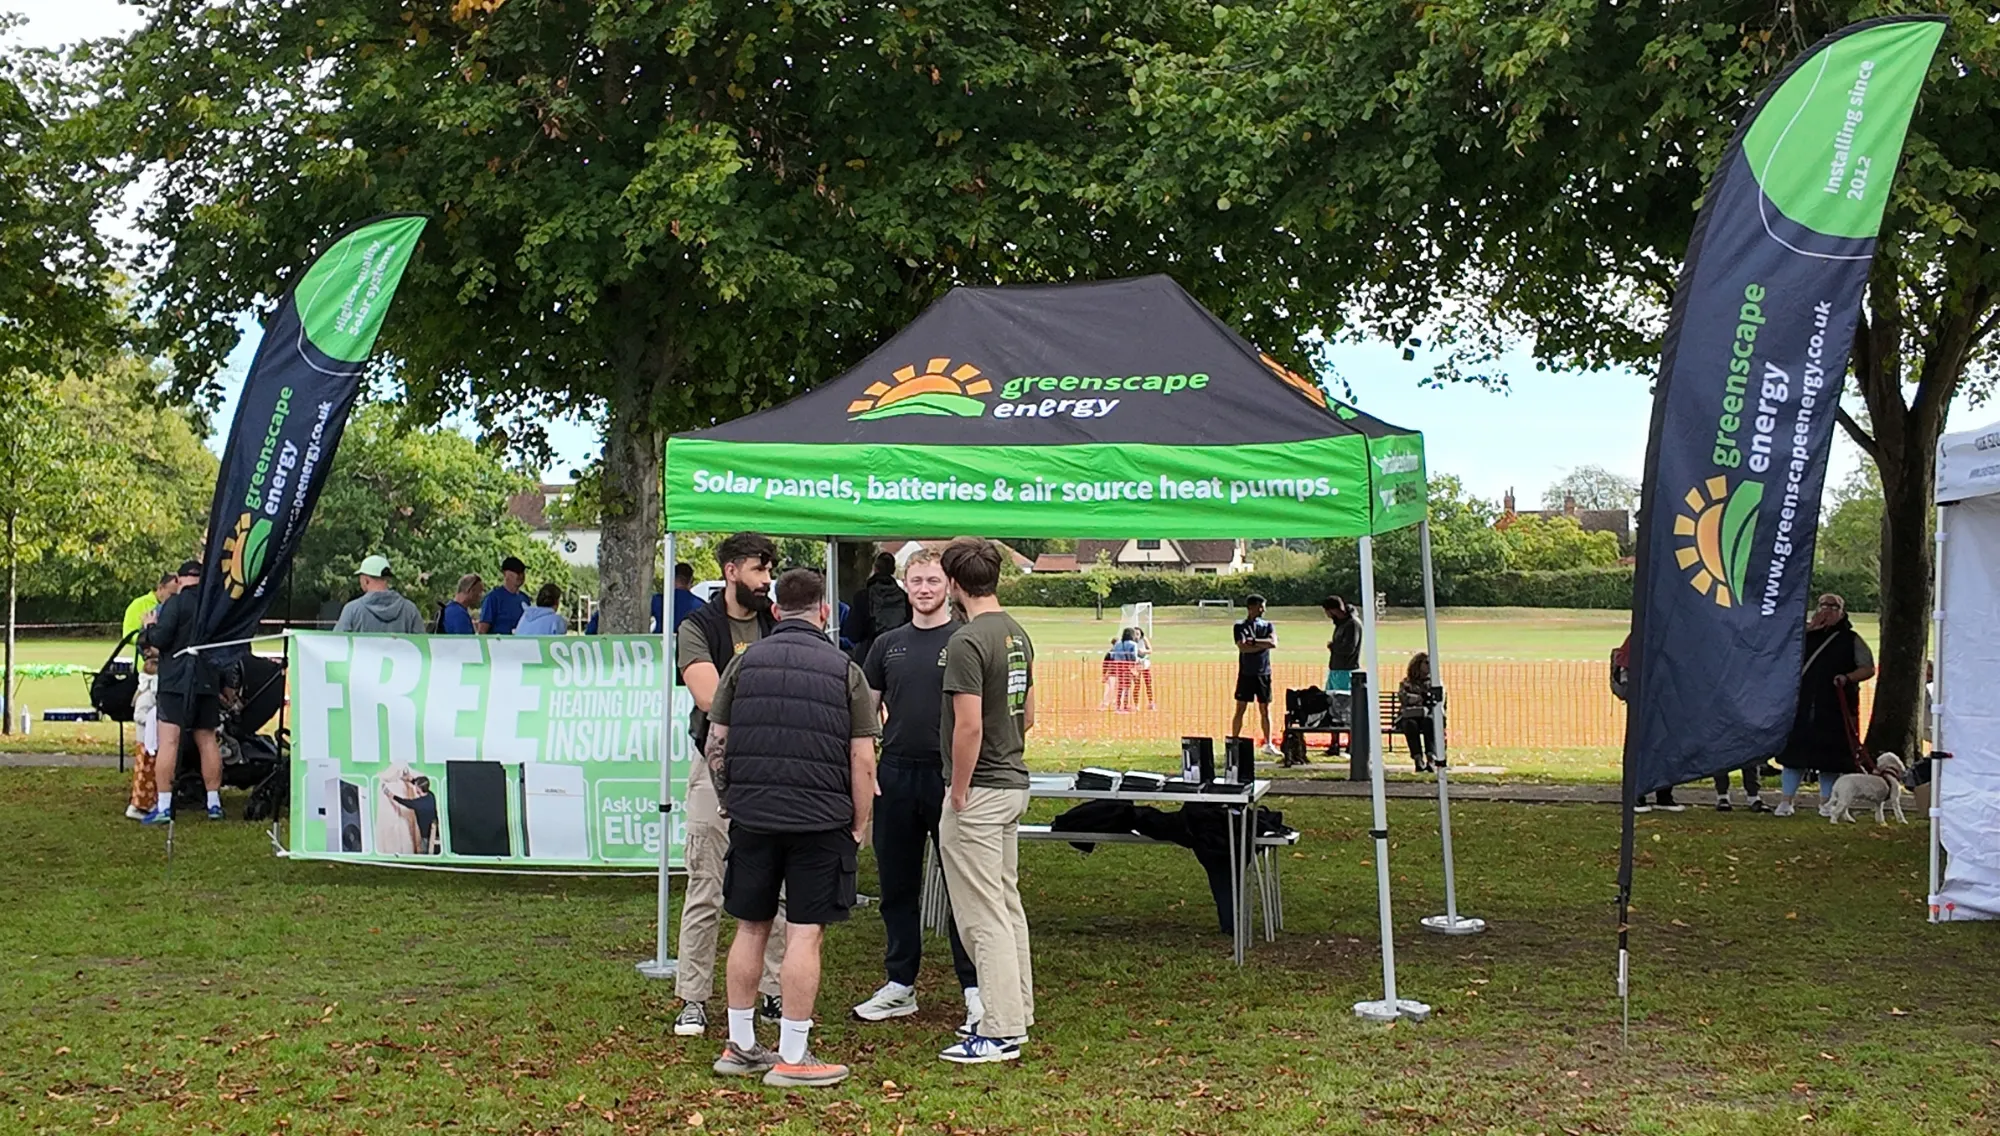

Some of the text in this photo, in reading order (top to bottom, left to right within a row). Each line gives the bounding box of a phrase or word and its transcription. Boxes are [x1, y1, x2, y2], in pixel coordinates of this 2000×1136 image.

[1824, 60, 1875, 194] Installing since
[1846, 156, 1872, 200] 2012
[349, 299, 371, 336] Solar
[1000, 373, 1210, 399] greenscape
[1713, 283, 1767, 469] greenscape
[993, 398, 1120, 418] energy
[1750, 362, 1789, 473] energy
[245, 386, 293, 510] greenscape
[1762, 300, 1833, 616] www.greenscapeenergy.co.uk
[265, 440, 297, 515] energy
[692, 469, 1339, 504] Solar panels, batteries & air source heat pumps.
[549, 640, 655, 688] SOLAR
[296, 635, 543, 764] FREE
[548, 690, 623, 718] HEATING
[602, 796, 632, 813] Ask
[635, 797, 657, 813] Us
